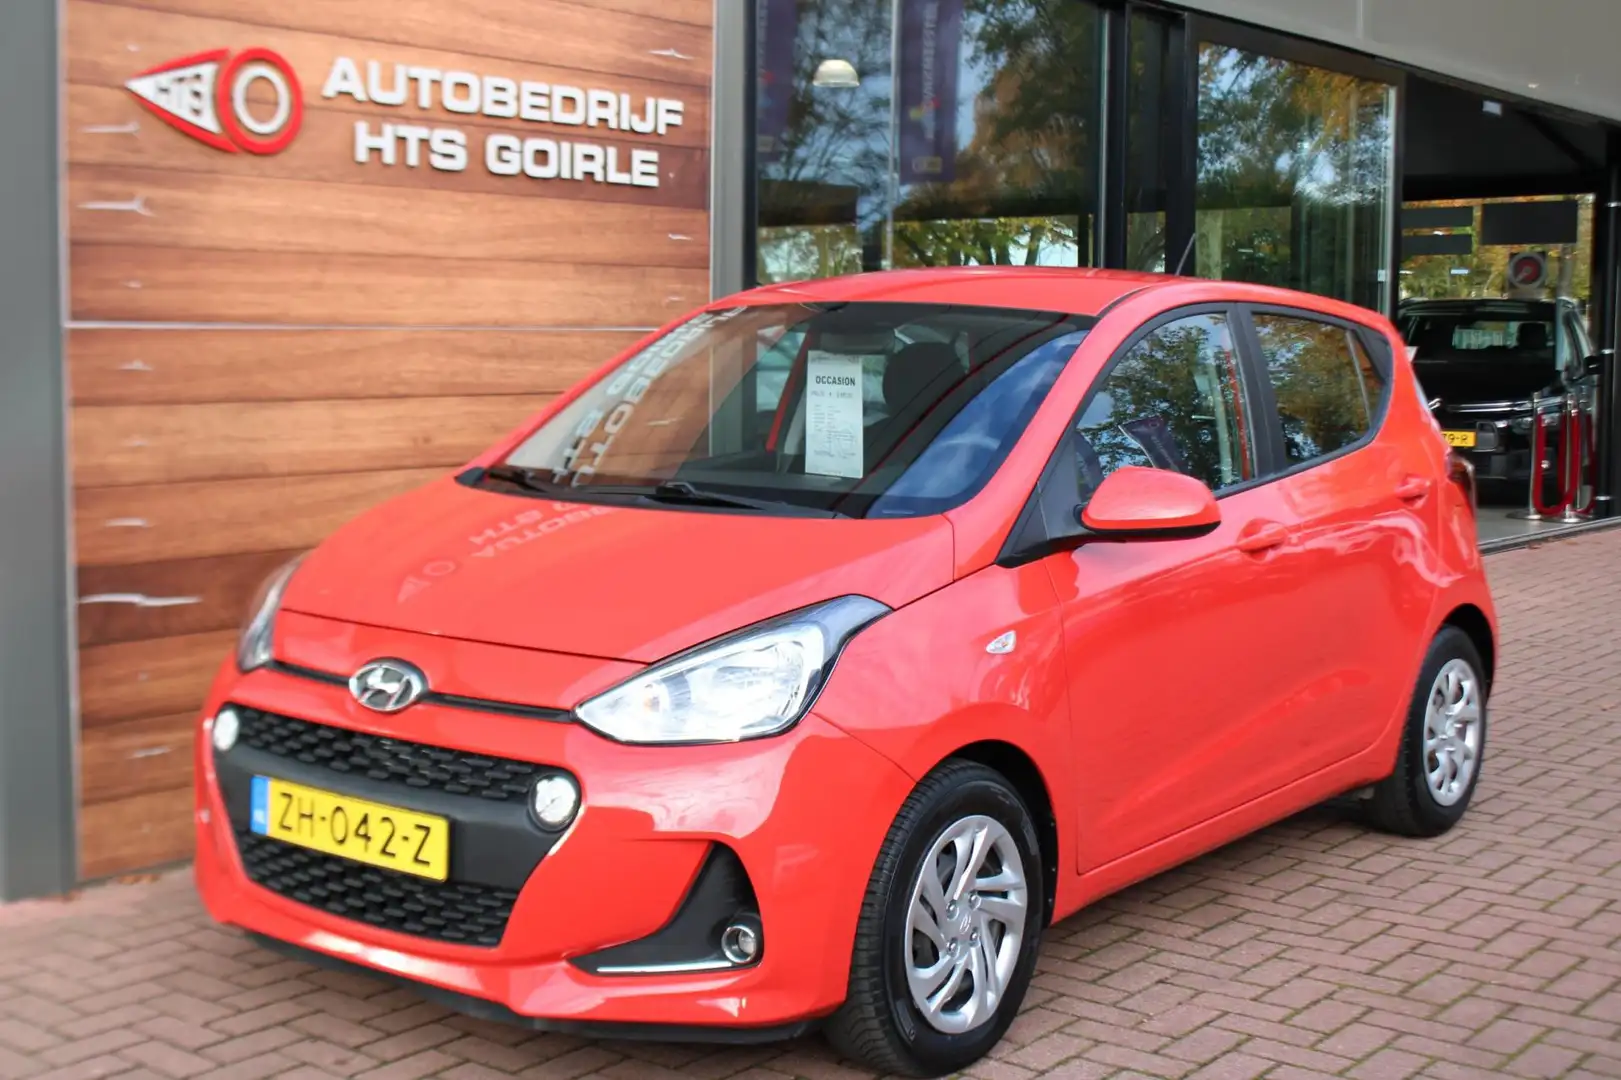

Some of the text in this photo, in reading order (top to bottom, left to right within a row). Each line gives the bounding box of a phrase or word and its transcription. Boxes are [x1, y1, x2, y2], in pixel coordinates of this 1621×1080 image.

[322, 56, 685, 135] AUTOBEDRIJF
[354, 121, 660, 187] HTS GOIRLE
[815, 375, 856, 387] OCCASION
[278, 791, 431, 868] ZH-042-Z
